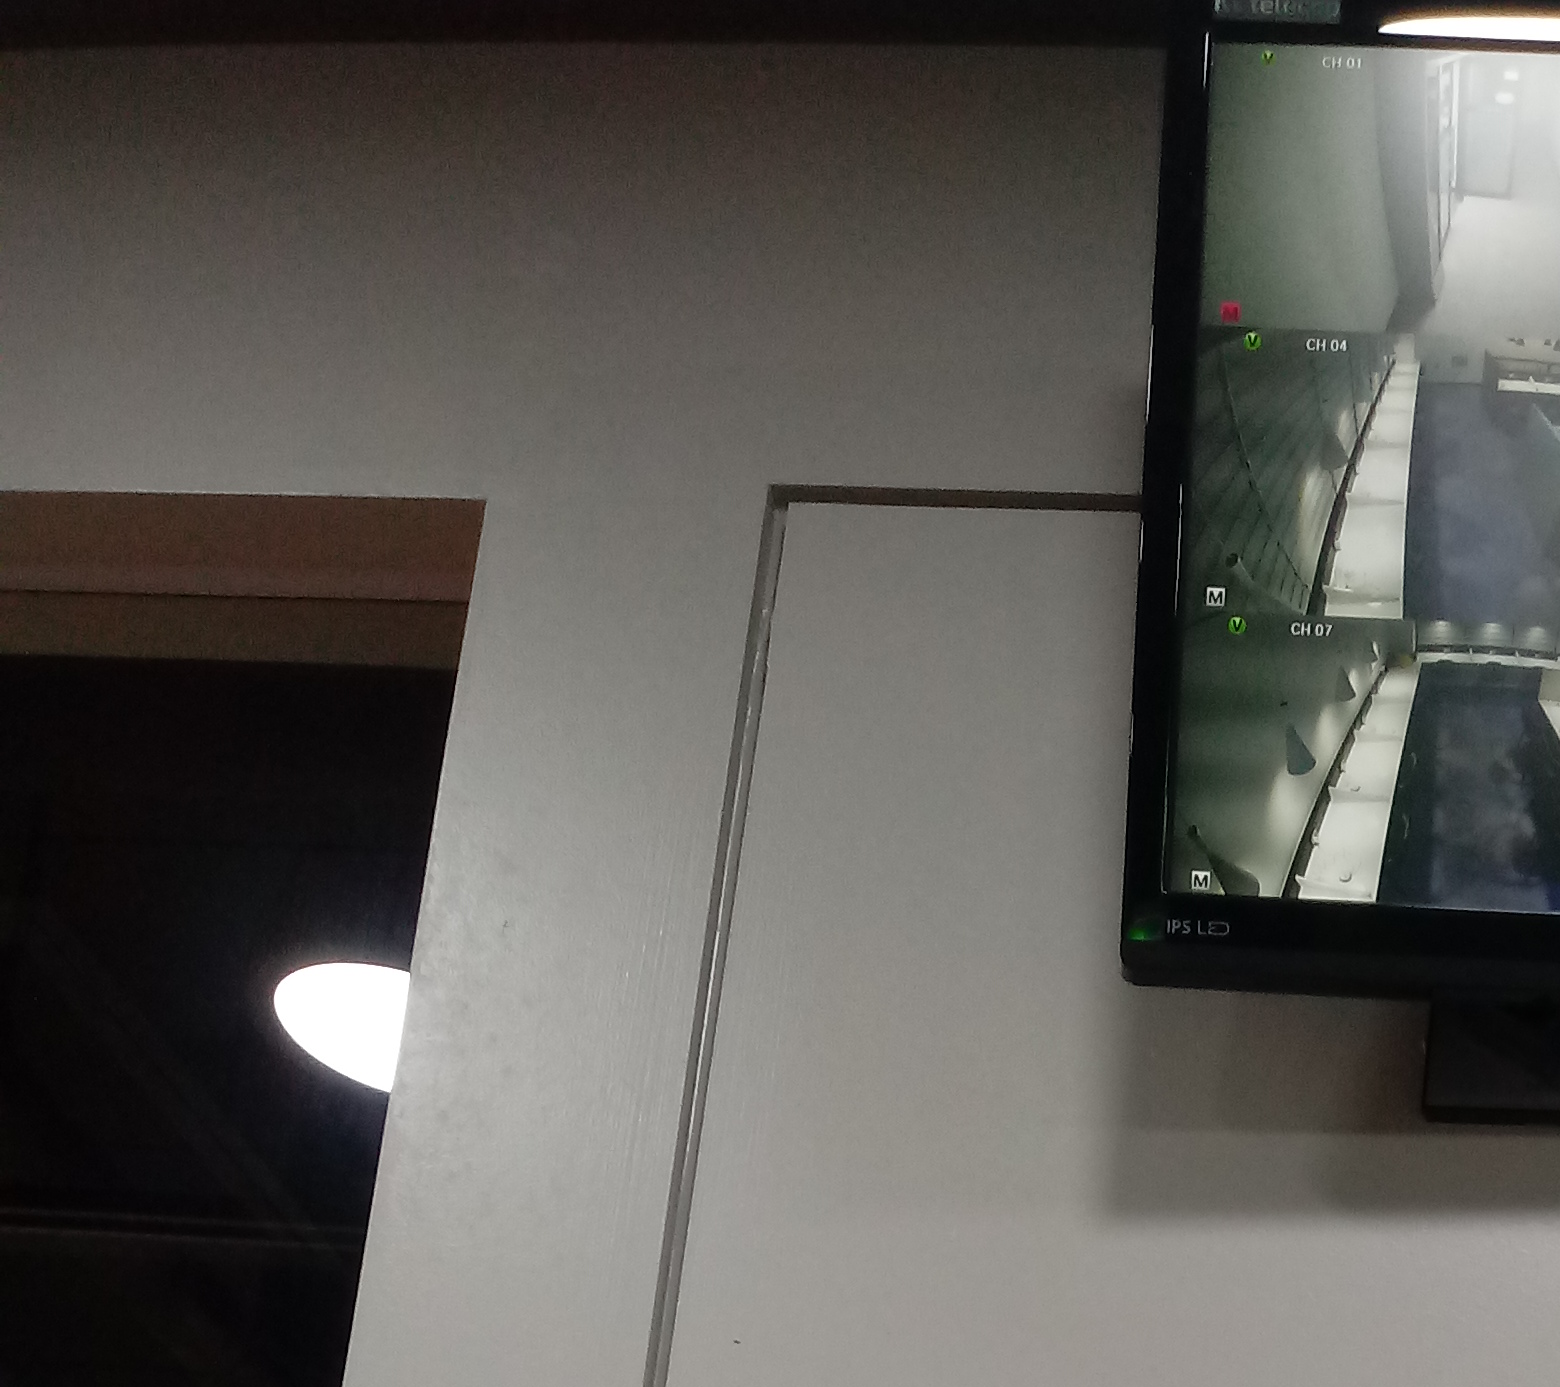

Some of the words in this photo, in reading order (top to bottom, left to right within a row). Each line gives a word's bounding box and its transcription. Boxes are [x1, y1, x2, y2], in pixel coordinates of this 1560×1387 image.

[1321, 56, 1342, 70] CH
[1346, 56, 1362, 70] 01
[1305, 338, 1327, 352] CH
[1330, 339, 1348, 352] 04
[1290, 622, 1311, 637] CH
[1314, 623, 1333, 637] 07
[1166, 919, 1192, 934] IPS
